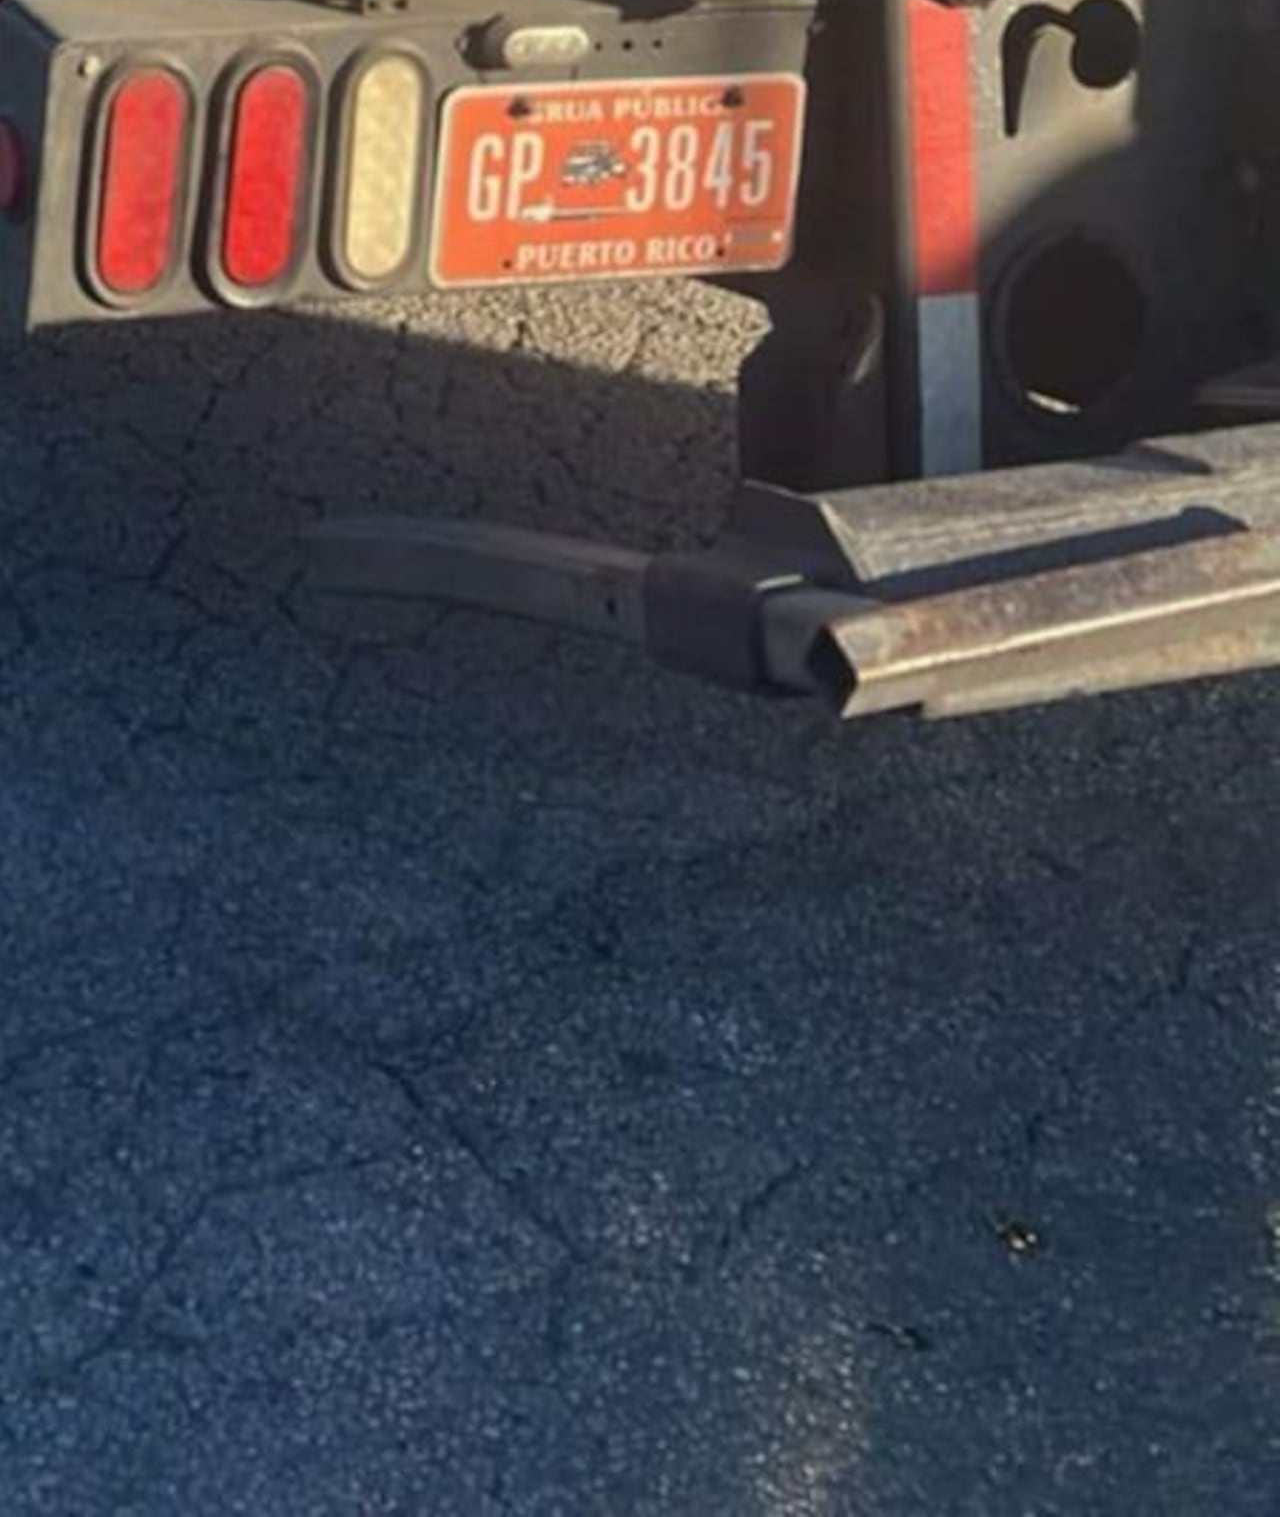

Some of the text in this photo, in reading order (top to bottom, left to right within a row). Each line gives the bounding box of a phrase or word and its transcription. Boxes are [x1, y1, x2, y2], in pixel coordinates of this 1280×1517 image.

[465, 118, 774, 222] GP 3845
[516, 232, 717, 270] PUERTO RICO
